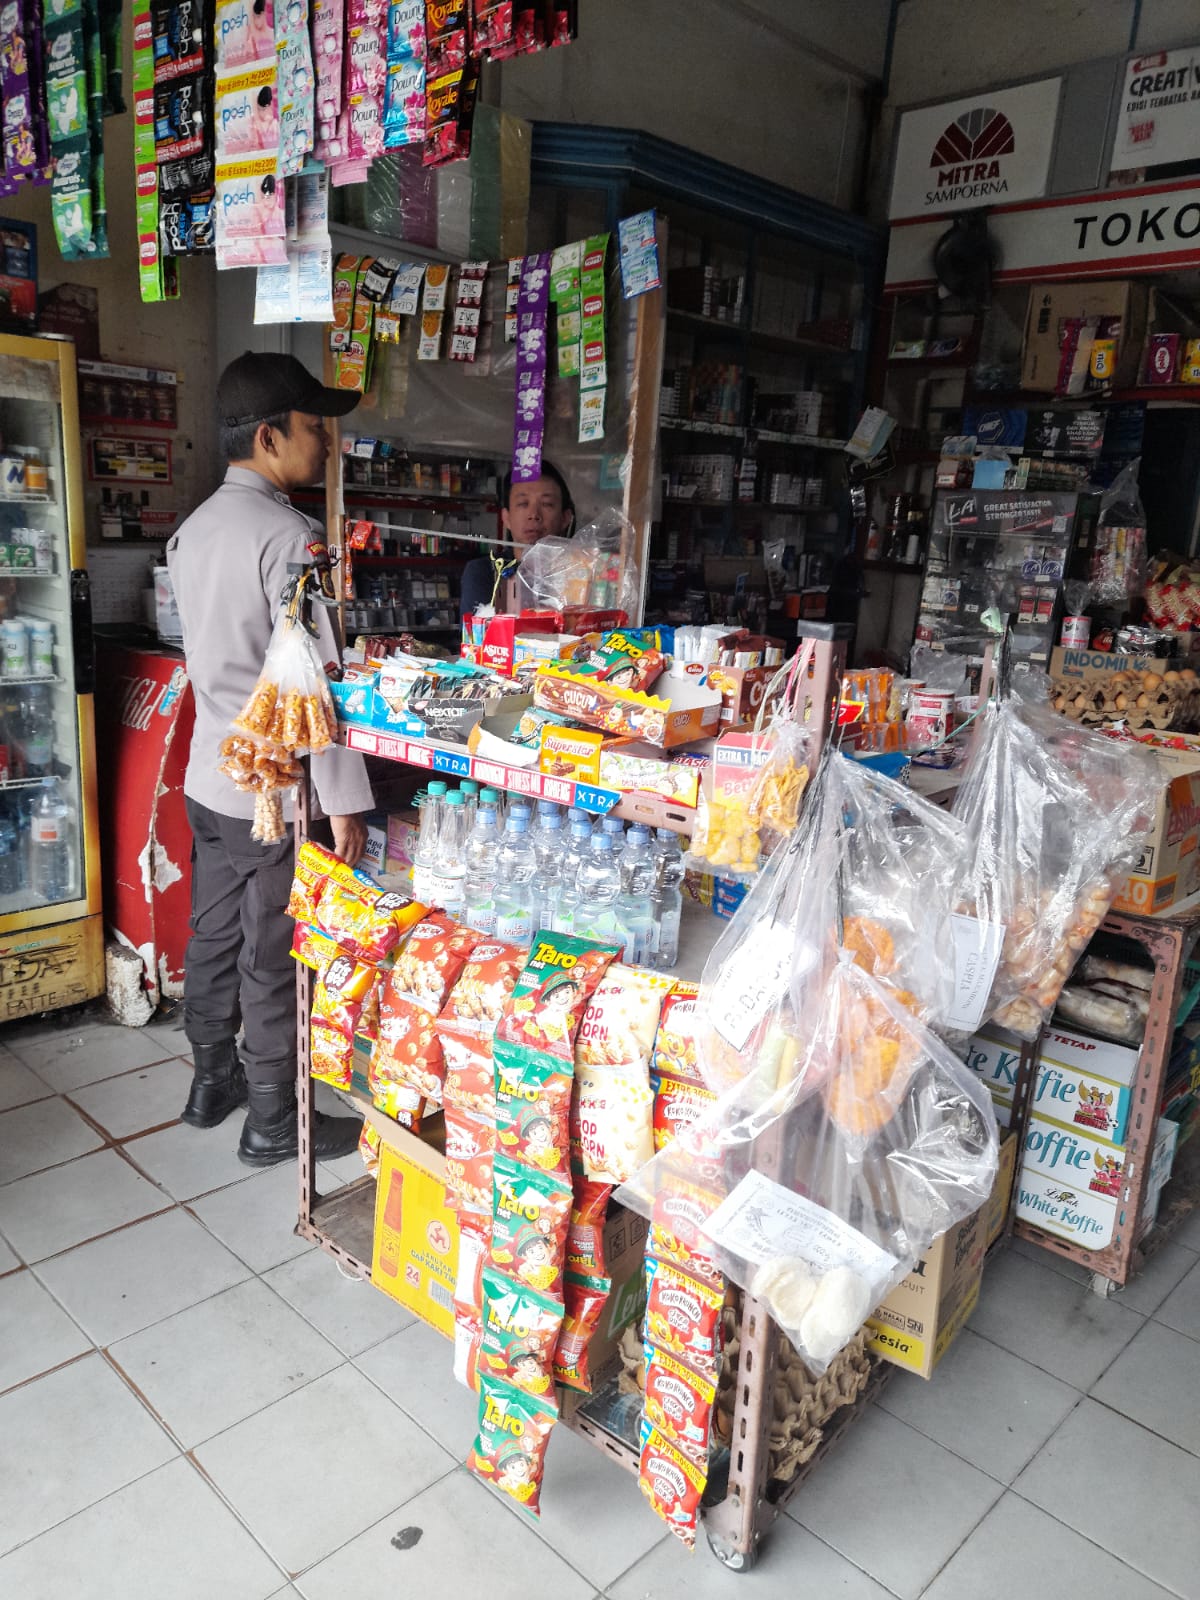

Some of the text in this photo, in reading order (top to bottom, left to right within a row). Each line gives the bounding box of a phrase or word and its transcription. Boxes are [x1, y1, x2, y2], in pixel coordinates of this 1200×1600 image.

[222, 6, 249, 44] posh
[394, 4, 425, 25] Downy
[351, 38, 380, 56] Downy
[391, 73, 424, 93] Downy
[222, 96, 251, 131] posh
[351, 107, 379, 123] Downy
[937, 160, 1000, 188] MITRA
[223, 183, 256, 216] posh
[924, 179, 1009, 206] SAMPOERNA
[171, 202, 187, 251] posh
[1073, 202, 1200, 250] TOKO
[949, 499, 975, 520] LA
[604, 632, 644, 659] Taro
[1063, 650, 1145, 672] INDOMILK
[543, 736, 595, 757] Superstar
[717, 750, 743, 762] EXTRA
[435, 754, 468, 772] XTRA
[577, 790, 614, 809] XTRA
[534, 942, 578, 969] Taro
[1054, 1034, 1097, 1051] TETAP
[498, 1069, 540, 1102] Taro
[498, 1184, 541, 1222] Taro
[1019, 1189, 1104, 1235] White Koffie
[405, 1265, 420, 1284] 24
[488, 1298, 531, 1339] Taro
[484, 1395, 525, 1437] Taro
